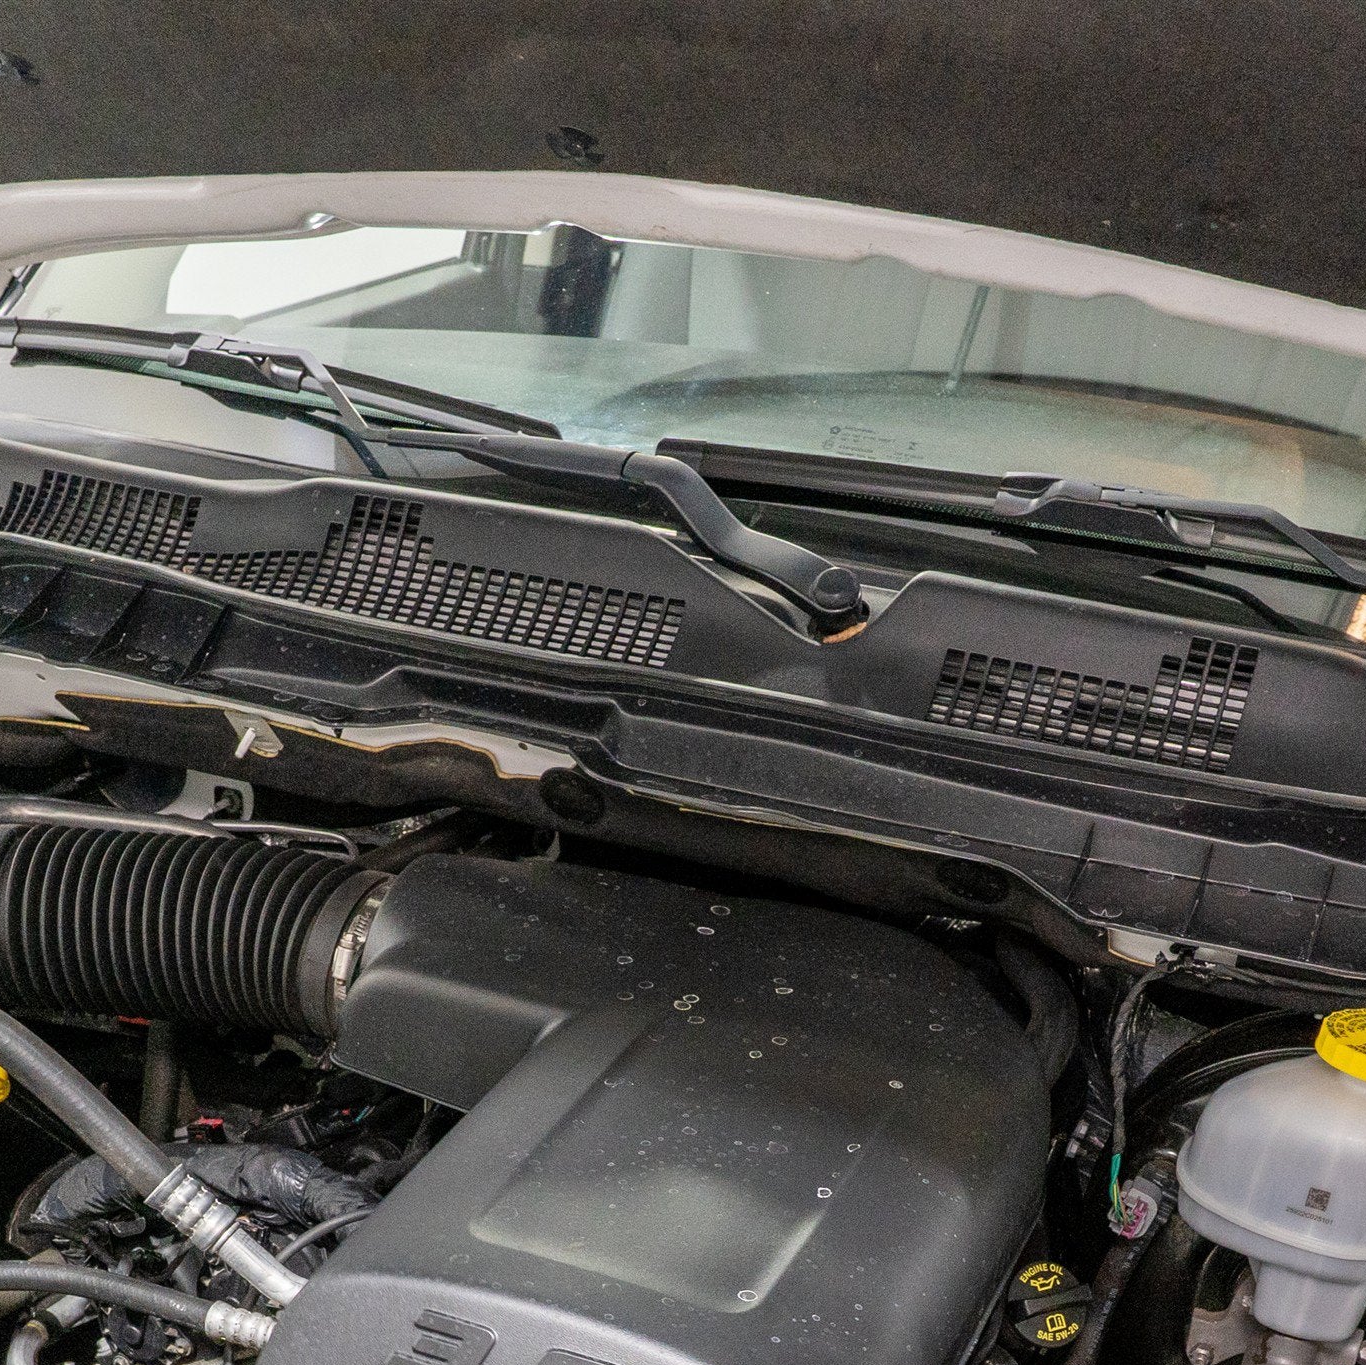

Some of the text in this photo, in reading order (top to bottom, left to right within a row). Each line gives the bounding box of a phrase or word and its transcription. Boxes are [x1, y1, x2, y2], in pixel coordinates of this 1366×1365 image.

[1019, 1263, 1064, 1284] ENGINE OIL
[1037, 1322, 1079, 1341] SAE 5W-20
